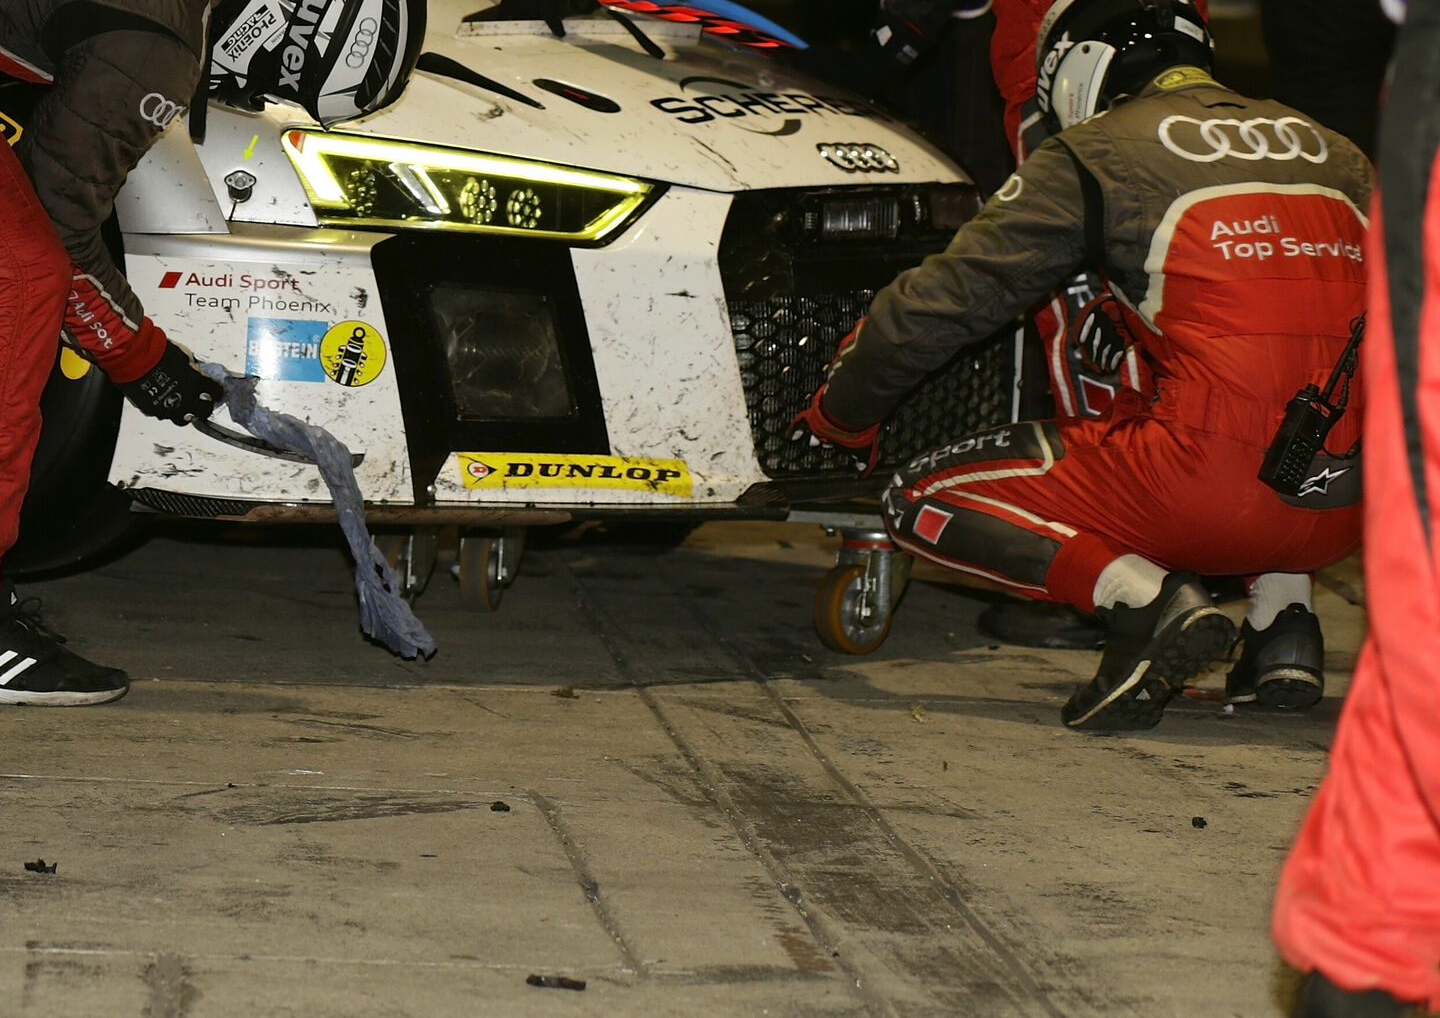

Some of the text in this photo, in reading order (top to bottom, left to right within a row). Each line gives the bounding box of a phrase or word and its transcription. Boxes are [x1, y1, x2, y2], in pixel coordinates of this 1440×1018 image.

[1036, 30, 1076, 114] uvex
[1211, 214, 1281, 241] Audi
[1213, 239, 1275, 261] Top
[185, 272, 300, 292] Audi Sport
[185, 292, 331, 314] Team Phoenix
[908, 429, 1012, 474] Sport
[504, 462, 682, 482] DUNLOP
